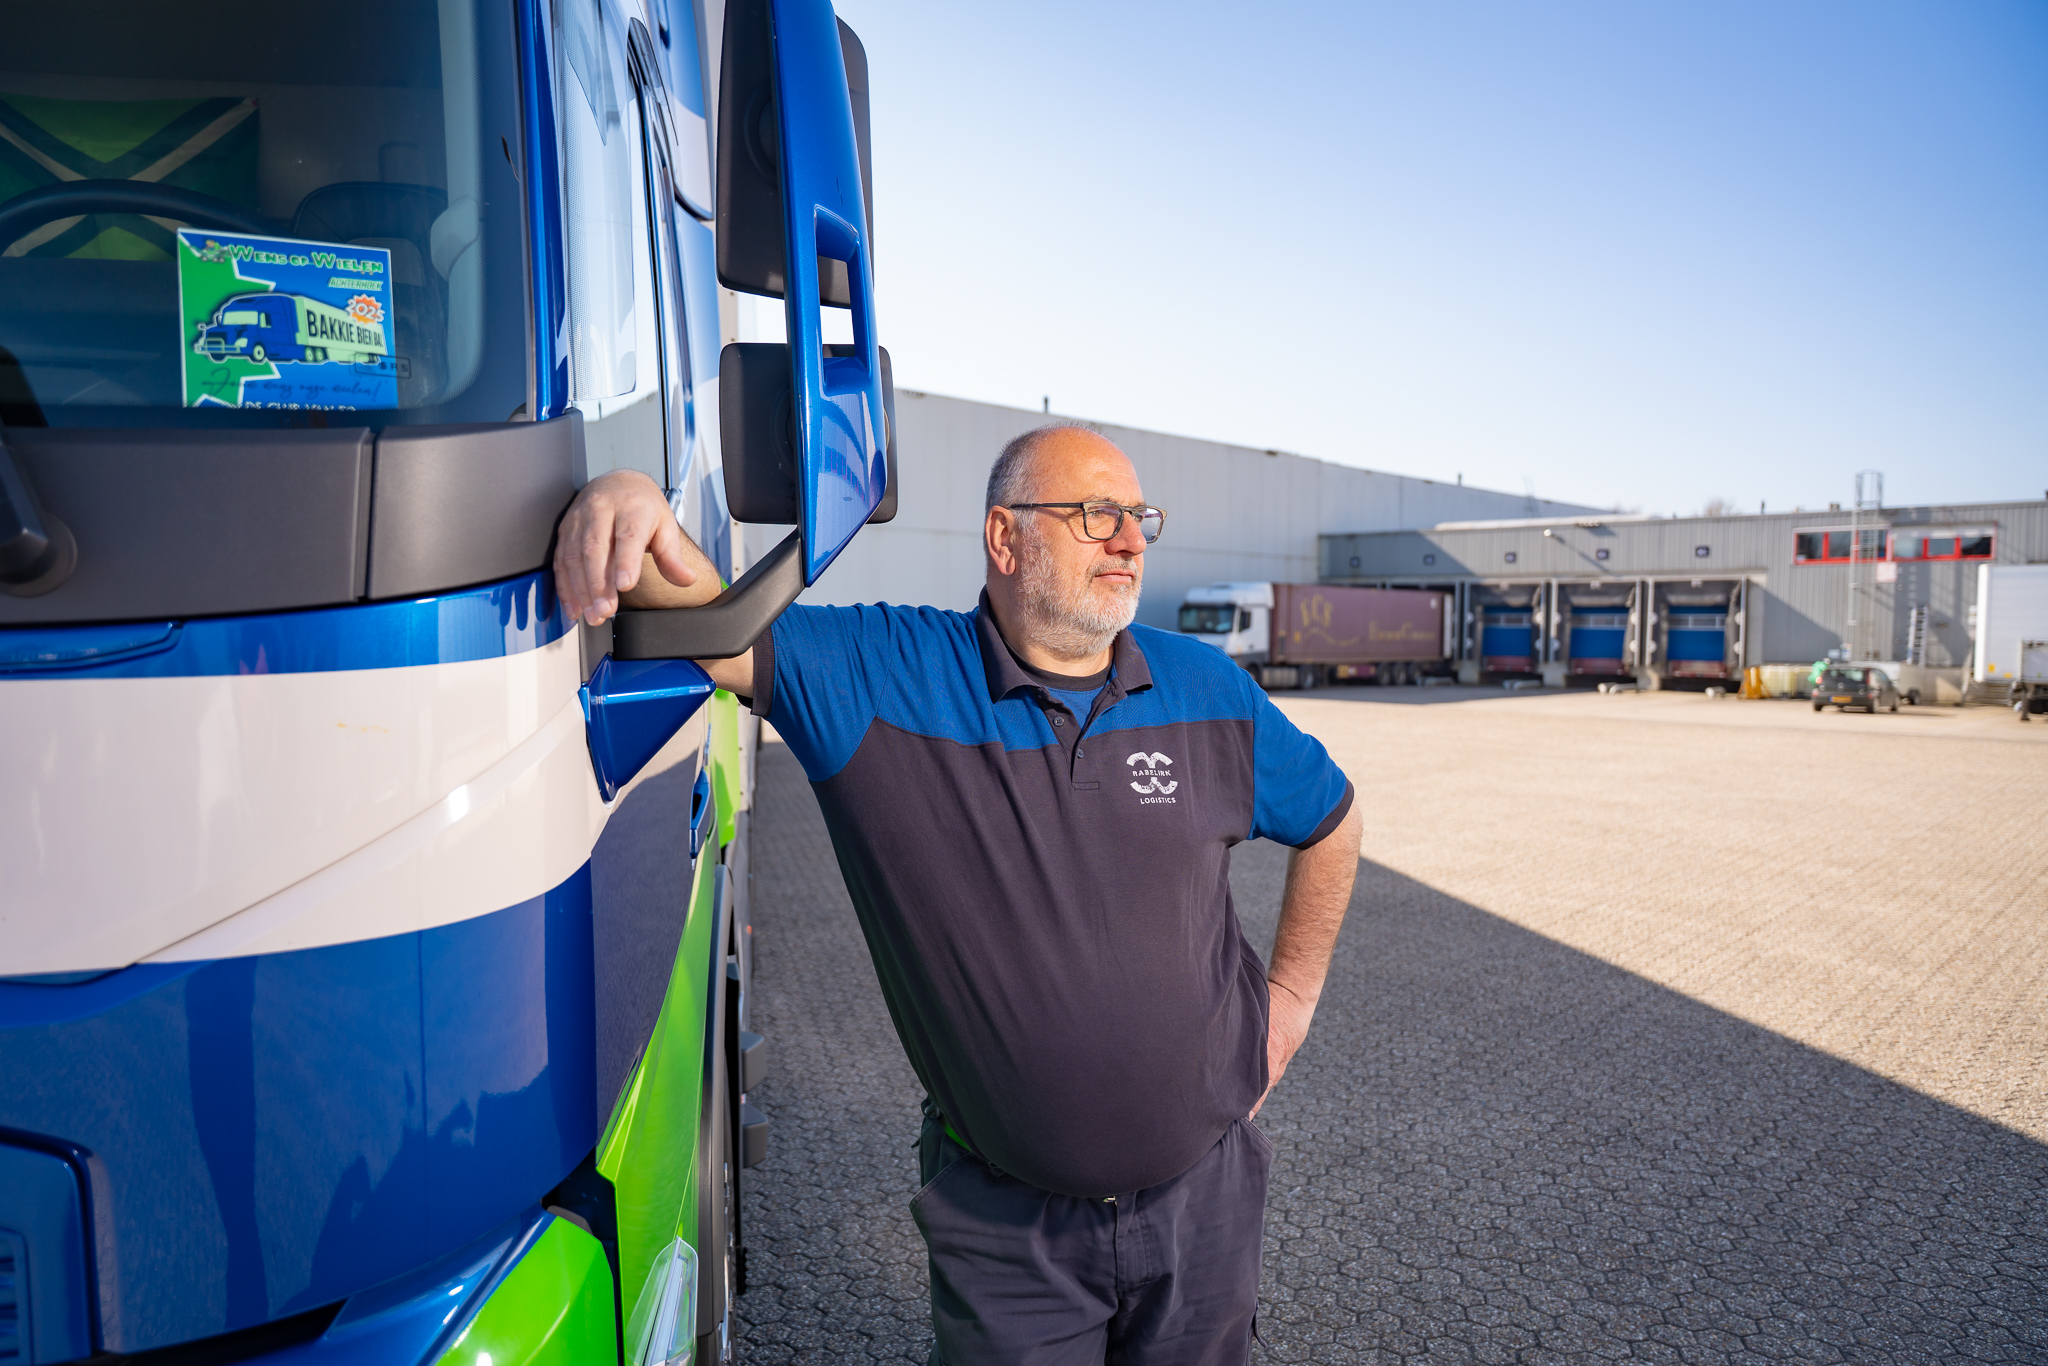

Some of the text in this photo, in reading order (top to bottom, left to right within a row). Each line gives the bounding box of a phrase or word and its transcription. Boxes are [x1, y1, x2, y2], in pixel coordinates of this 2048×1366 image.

[328, 276, 384, 291] ACHTERHOEK
[345, 298, 386, 323] 2025
[306, 309, 355, 343] BAKKIE
[356, 325, 373, 346] BIER
[1132, 769, 1172, 777] RABELINK
[1140, 796, 1177, 805] LOGISTICS
